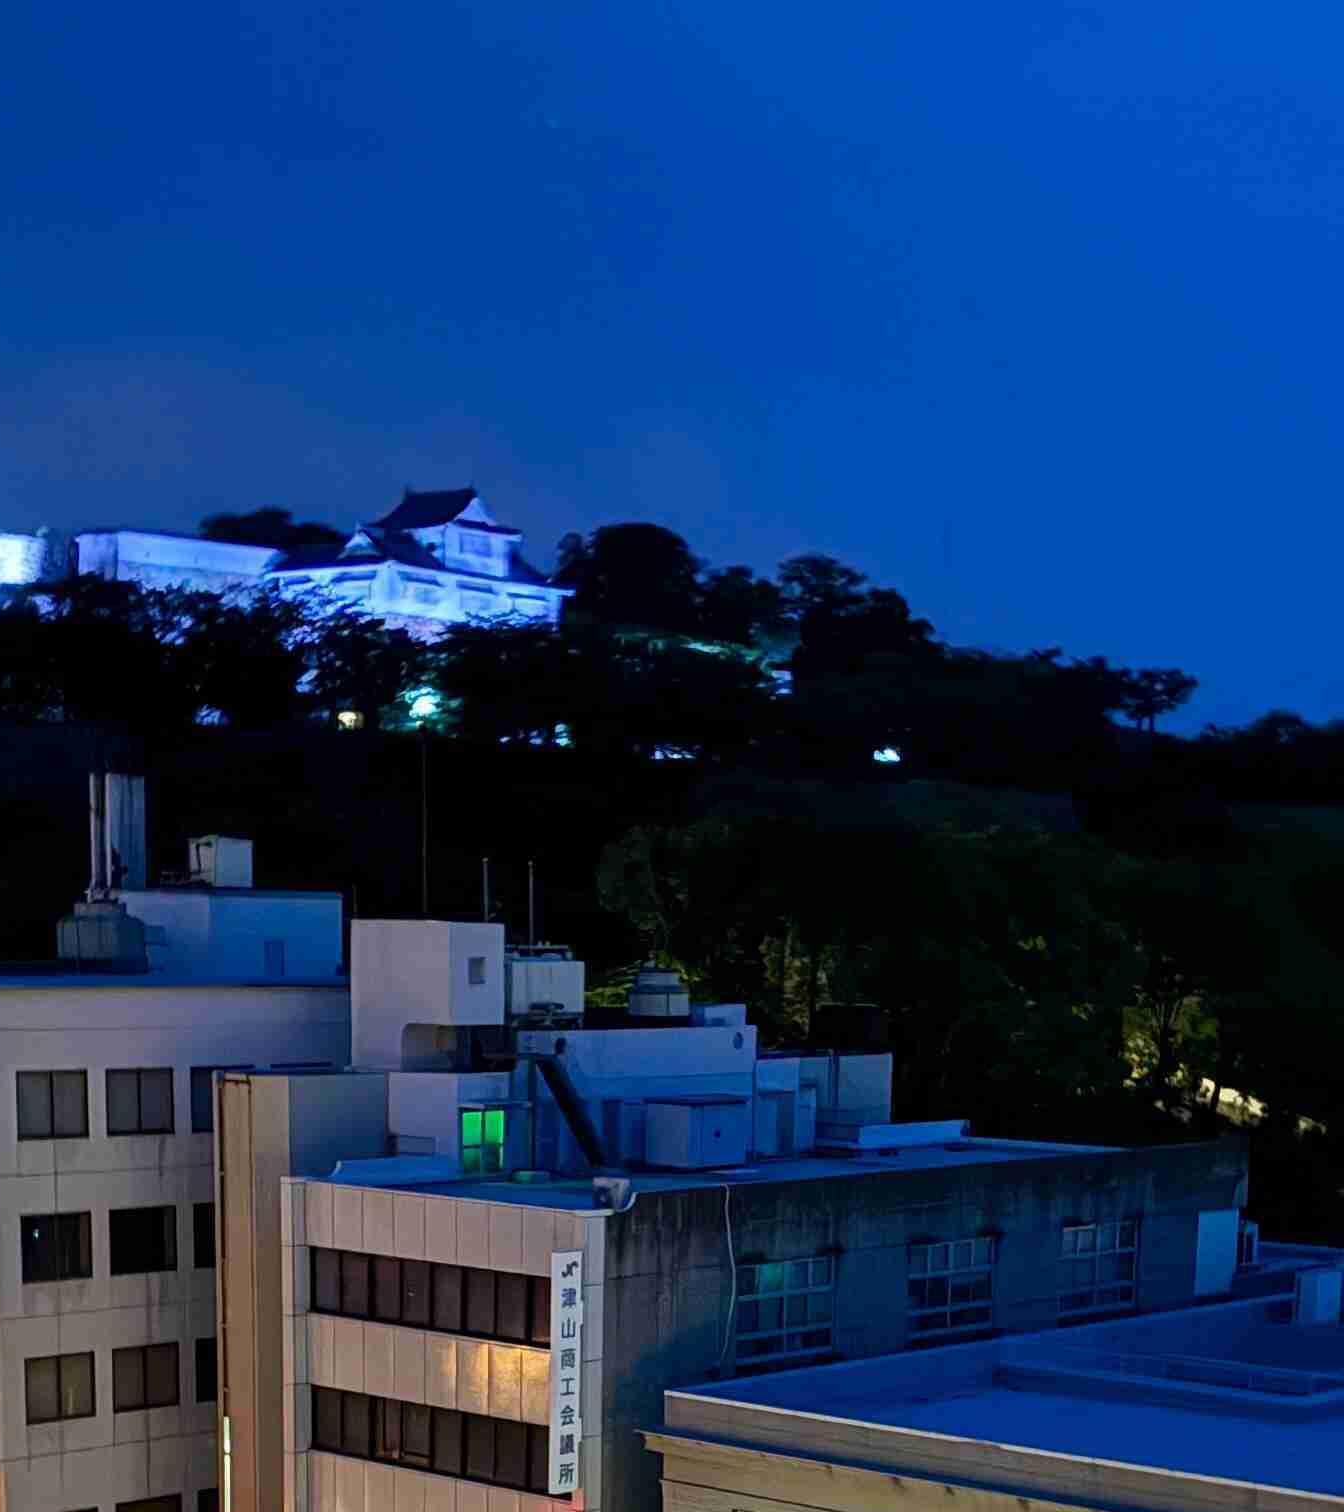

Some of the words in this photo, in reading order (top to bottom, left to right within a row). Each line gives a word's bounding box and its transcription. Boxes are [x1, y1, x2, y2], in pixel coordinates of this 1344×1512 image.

[558, 1286, 577, 1485] 津山商工会議所
